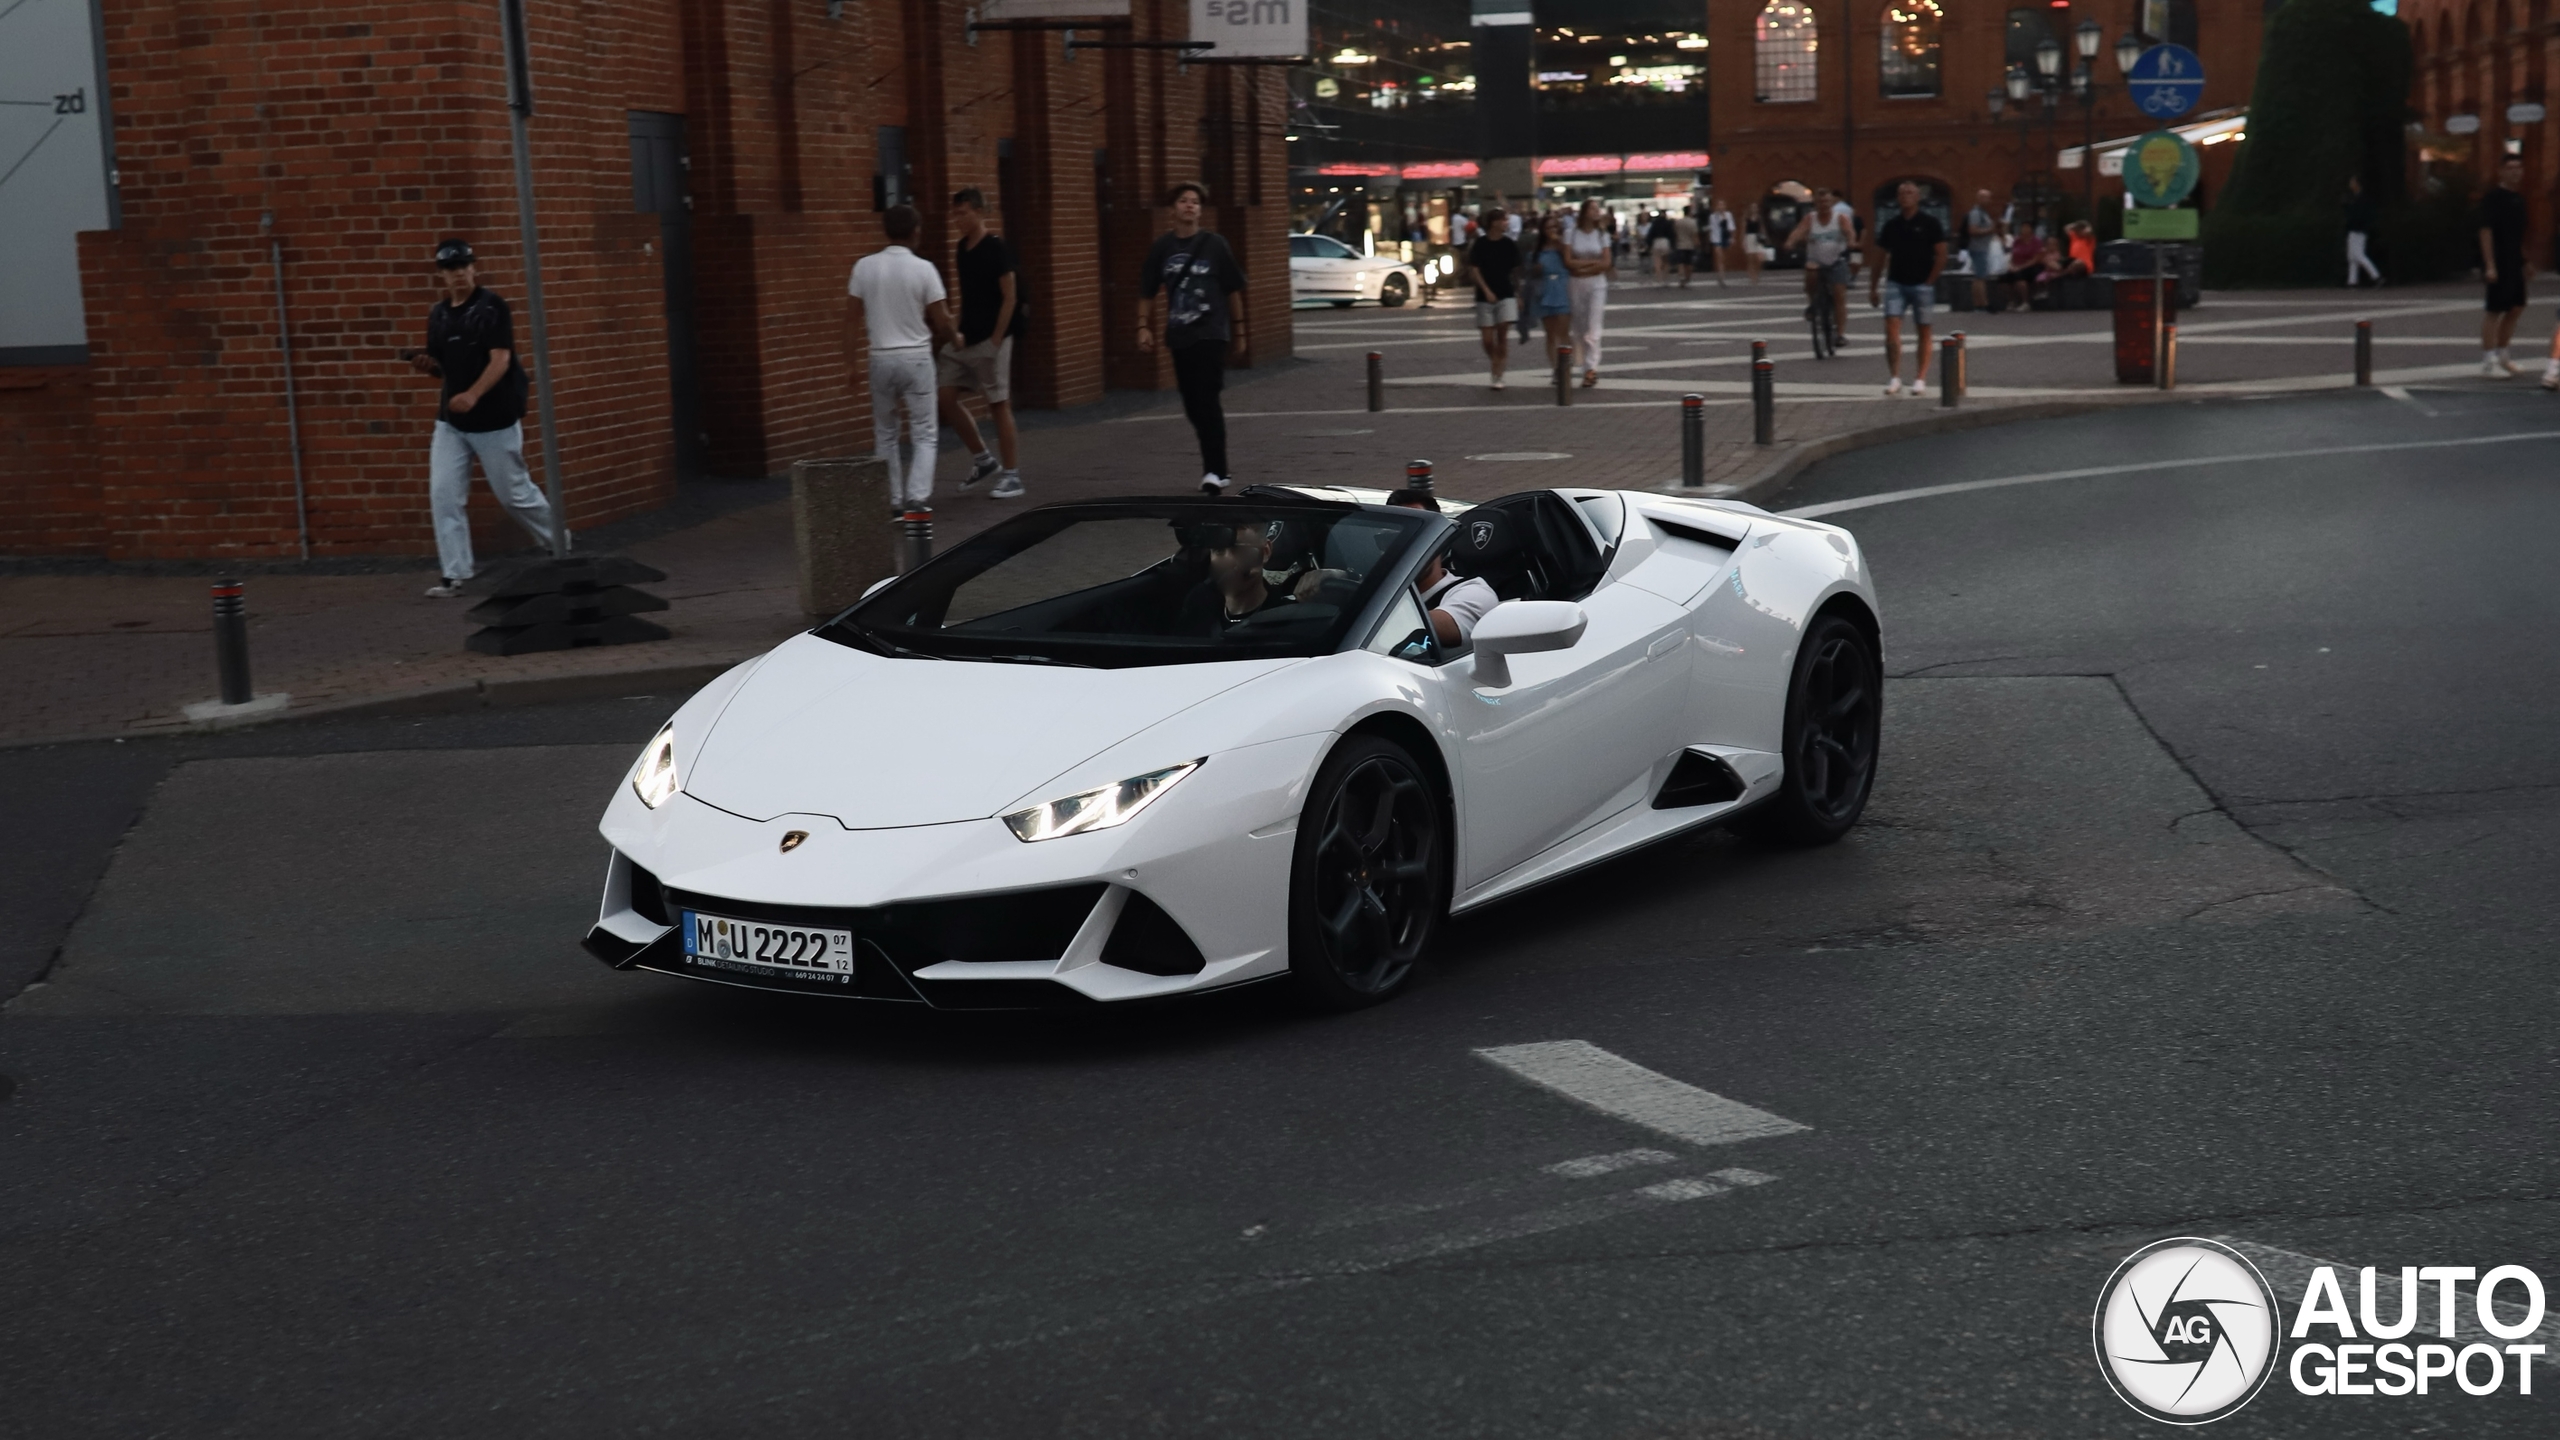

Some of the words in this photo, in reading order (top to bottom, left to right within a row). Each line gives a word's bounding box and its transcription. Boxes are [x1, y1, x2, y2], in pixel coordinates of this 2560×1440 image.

[54, 87, 85, 114] zd
[687, 938, 693, 948] D
[697, 918, 714, 954] M
[730, 922, 749, 960] U
[754, 927, 829, 969] 2222
[834, 935, 847, 945] 07
[697, 957, 716, 967] BLINK
[717, 961, 749, 973] DETAILING
[749, 966, 775, 976] STUDIO
[835, 959, 848, 970] 12
